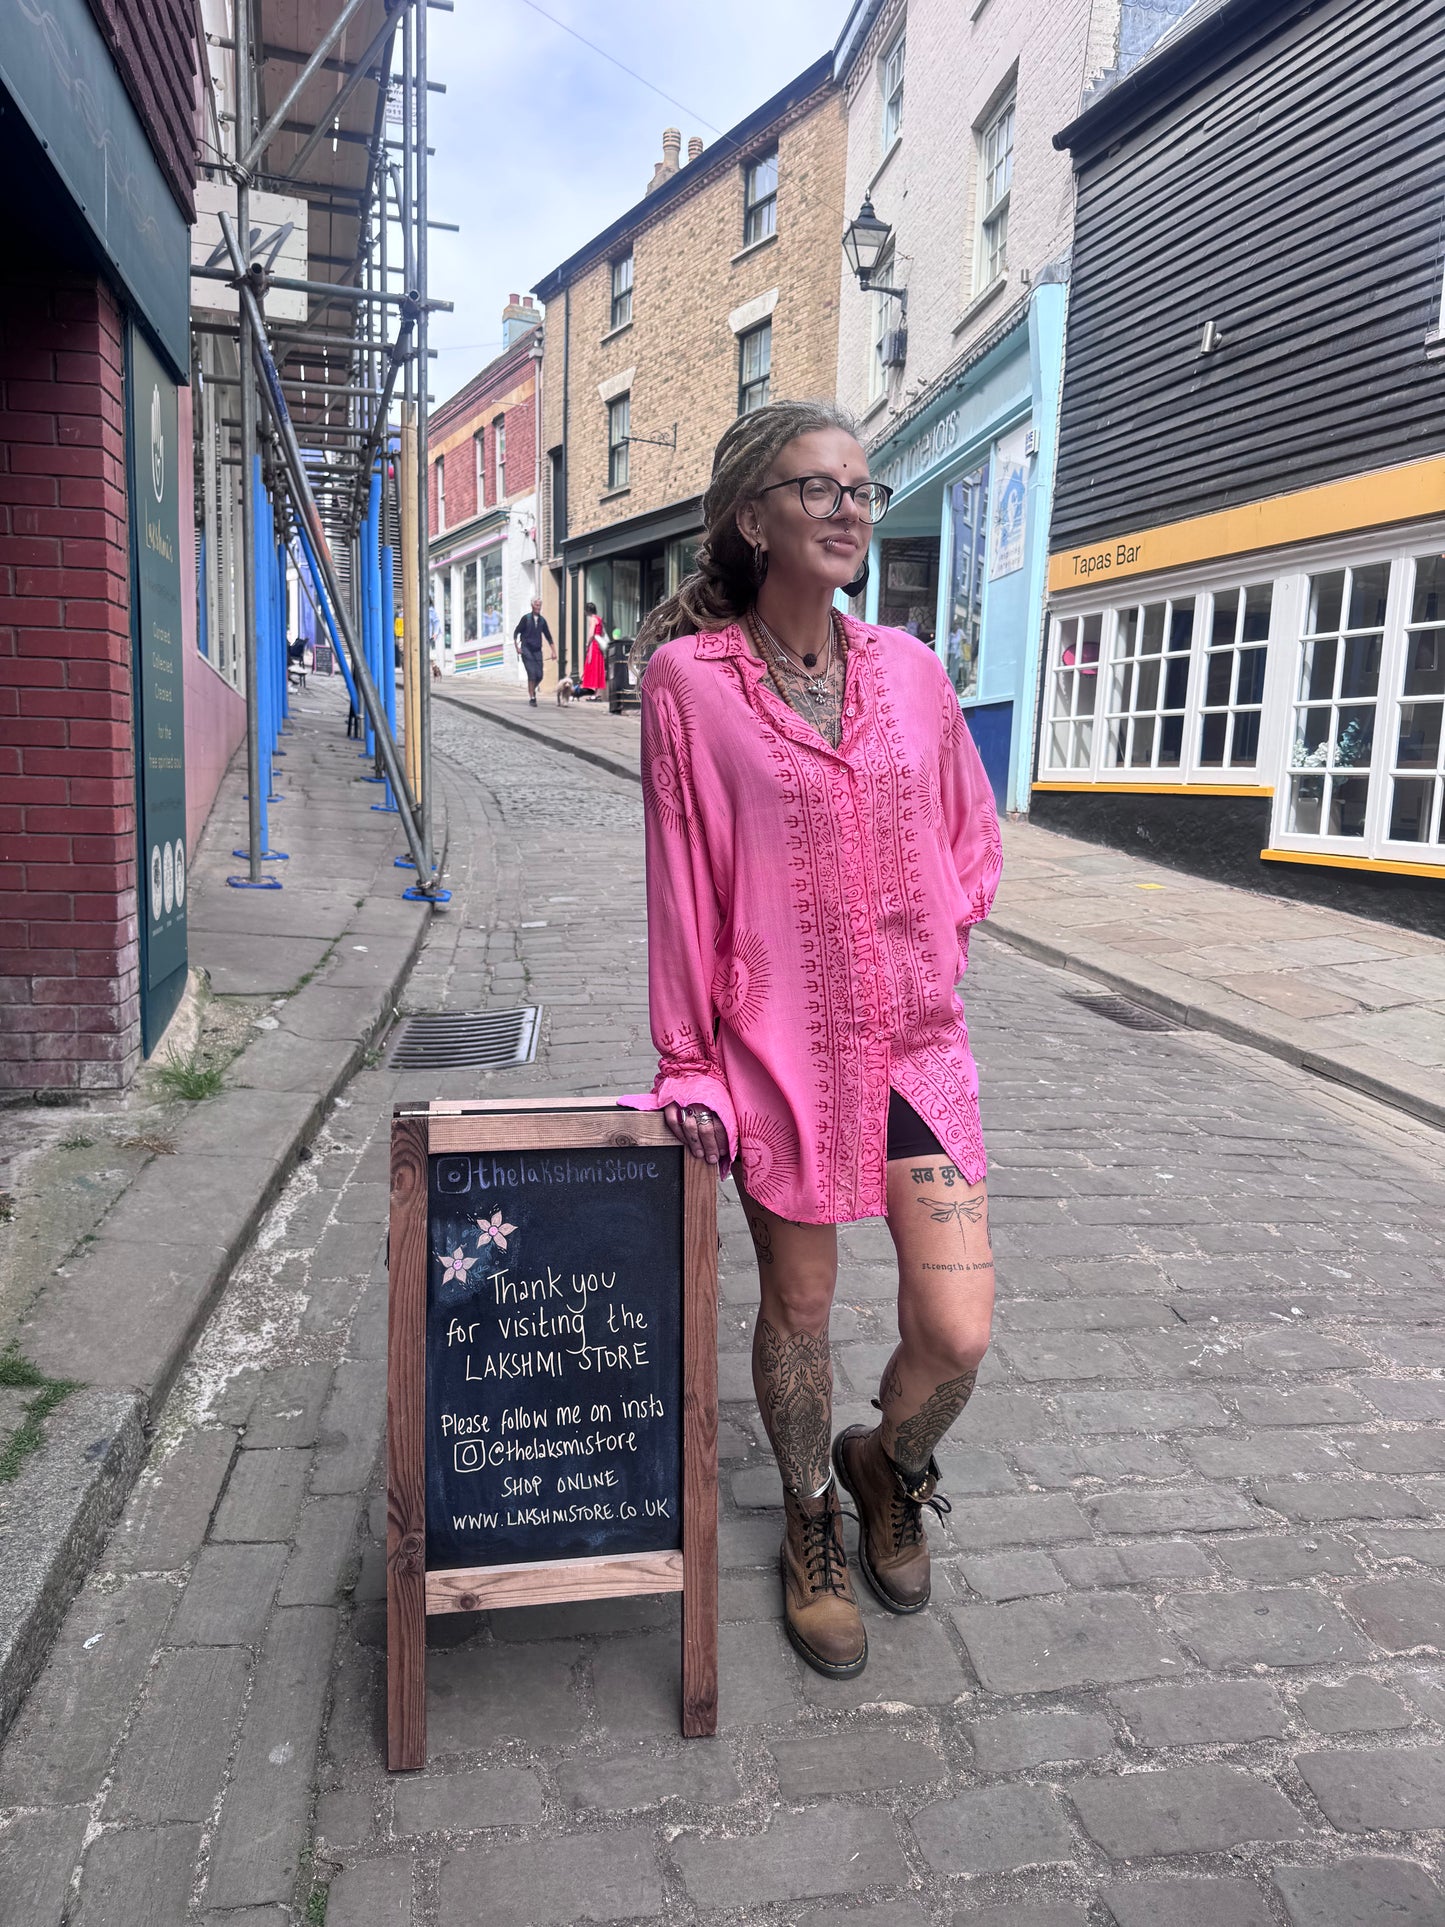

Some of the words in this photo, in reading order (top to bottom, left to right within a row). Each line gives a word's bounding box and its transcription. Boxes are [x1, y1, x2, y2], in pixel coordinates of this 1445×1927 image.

[1072, 553, 1112, 577] Tapas
[1116, 544, 1141, 566] Bar
[910, 1166, 935, 1185] सब
[921, 1262, 964, 1273] strength
[487, 1266, 563, 1305] Thank
[566, 1271, 616, 1314] you
[446, 1318, 481, 1347] for
[498, 1306, 586, 1354] visiting
[607, 1303, 648, 1333] the
[465, 1351, 563, 1381] LAKSHMI
[578, 1342, 650, 1373] STORE
[441, 1413, 490, 1437] Please
[501, 1406, 547, 1435] follow
[556, 1405, 582, 1426] me
[590, 1404, 612, 1423] on
[620, 1394, 664, 1419] insta
[488, 1430, 638, 1466] @thelaksmistore
[501, 1475, 543, 1498] SHOP
[557, 1470, 619, 1493] ONLINE
